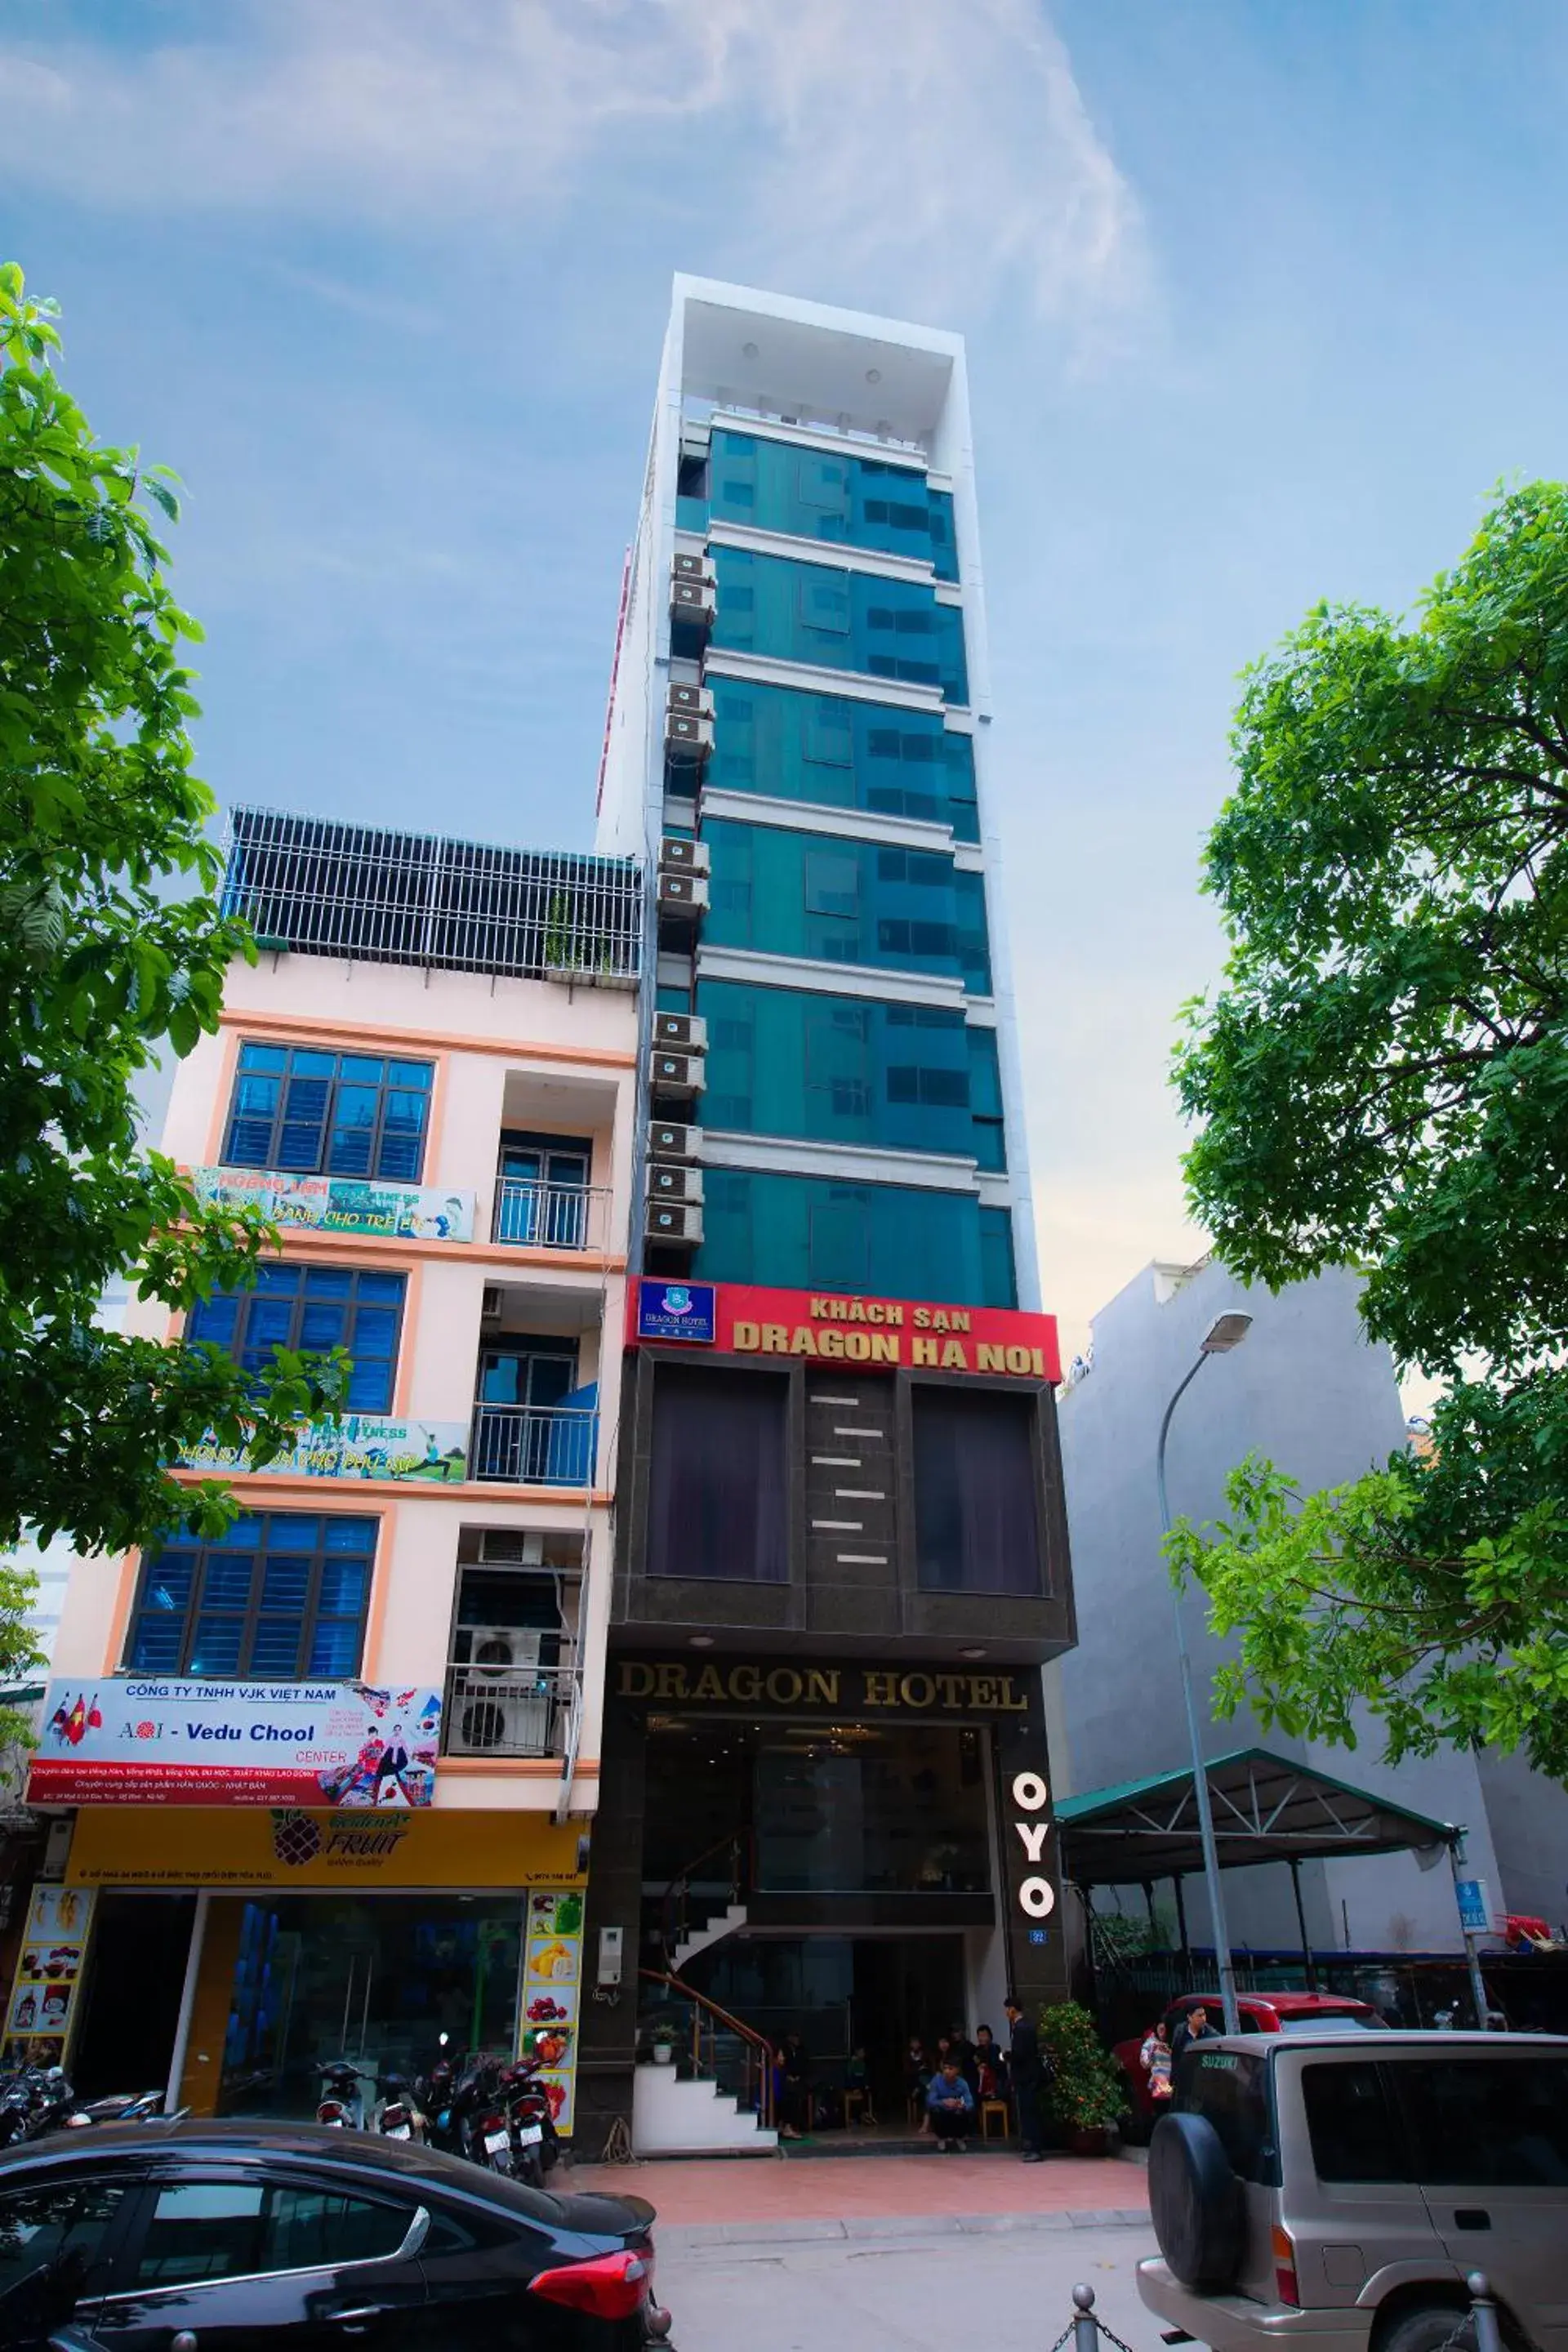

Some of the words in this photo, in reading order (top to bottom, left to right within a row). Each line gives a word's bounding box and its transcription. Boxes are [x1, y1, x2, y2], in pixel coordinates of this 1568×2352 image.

[645, 1312, 680, 1325] DRAGON
[810, 1296, 902, 1326] KHÁCH
[913, 1307, 970, 1334] SẠN
[733, 1321, 901, 1364] DRAGON
[911, 1336, 969, 1371] HA
[976, 1342, 1045, 1378] NOI
[126, 1683, 169, 1696] CÔNG
[174, 1686, 192, 1697] TY
[195, 1686, 234, 1698] TNHH
[238, 1687, 267, 1699] VJK
[270, 1687, 301, 1702] VIỆT
[305, 1689, 336, 1700] NAM
[617, 1661, 841, 1704] DRAGON
[862, 1670, 1028, 1710] HOTEL
[186, 1722, 243, 1740] Vedu
[250, 1724, 314, 1742] Chool
[295, 1750, 347, 1764] CENTER
[326, 1831, 408, 1855] FRUIT
[1012, 1771, 1054, 1918] OYO
[1201, 2055, 1238, 2069] SUZUKI
